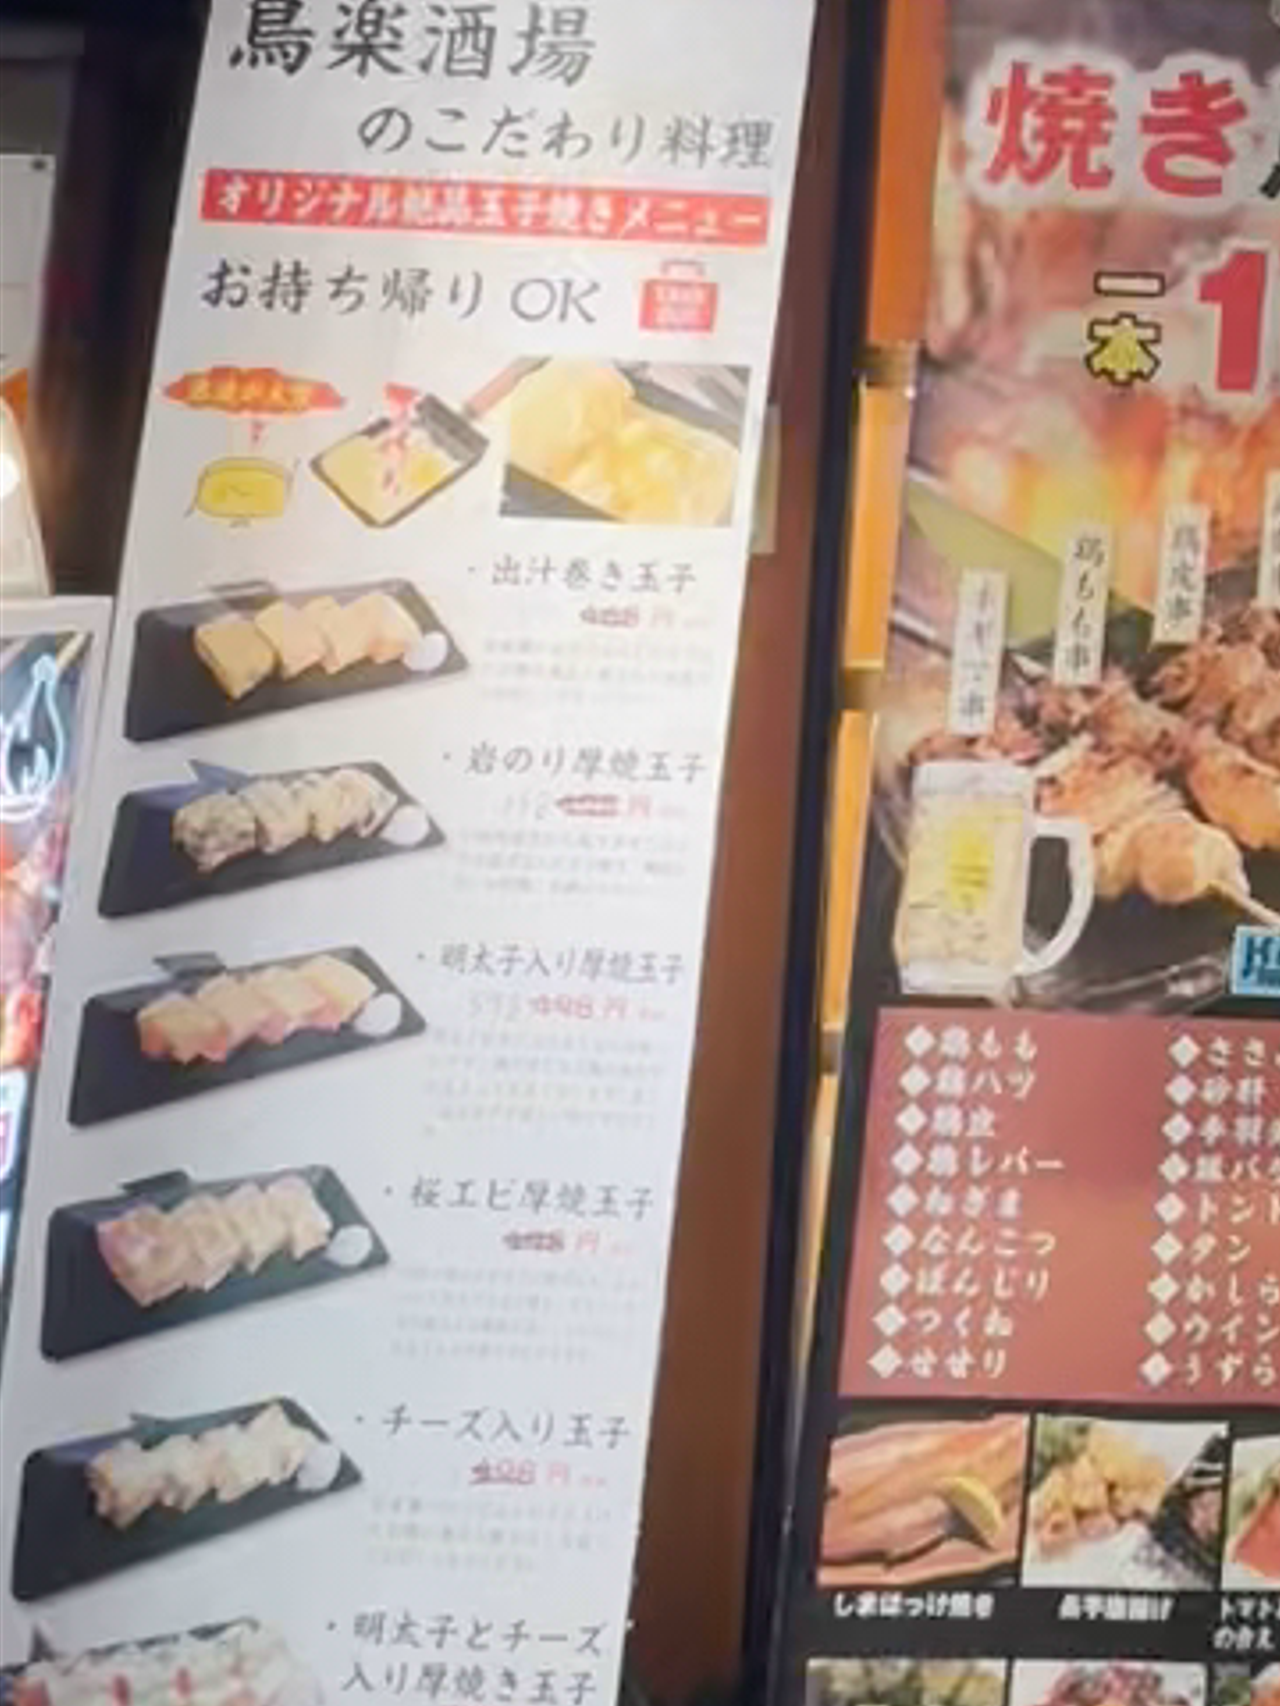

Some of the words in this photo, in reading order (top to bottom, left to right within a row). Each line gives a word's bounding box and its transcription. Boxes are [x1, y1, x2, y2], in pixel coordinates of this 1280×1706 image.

[358, 101, 776, 170] のこだわり料理
[202, 256, 485, 321] お持ち帰り
[510, 278, 600, 325] OK
[491, 552, 696, 594] 出汁巻き玉子
[410, 1174, 654, 1222] 桜エビ厚焼玉子
[920, 1224, 1057, 1258] なんこつ
[1190, 1230, 1251, 1265] タン
[911, 1306, 1014, 1338] つくね
[908, 1344, 1007, 1380] せせり
[381, 1404, 631, 1450] チーズ入り玉子
[353, 1609, 608, 1657] 明太子とチーズ
[341, 1660, 597, 1706] 入り厚焼き玉子
